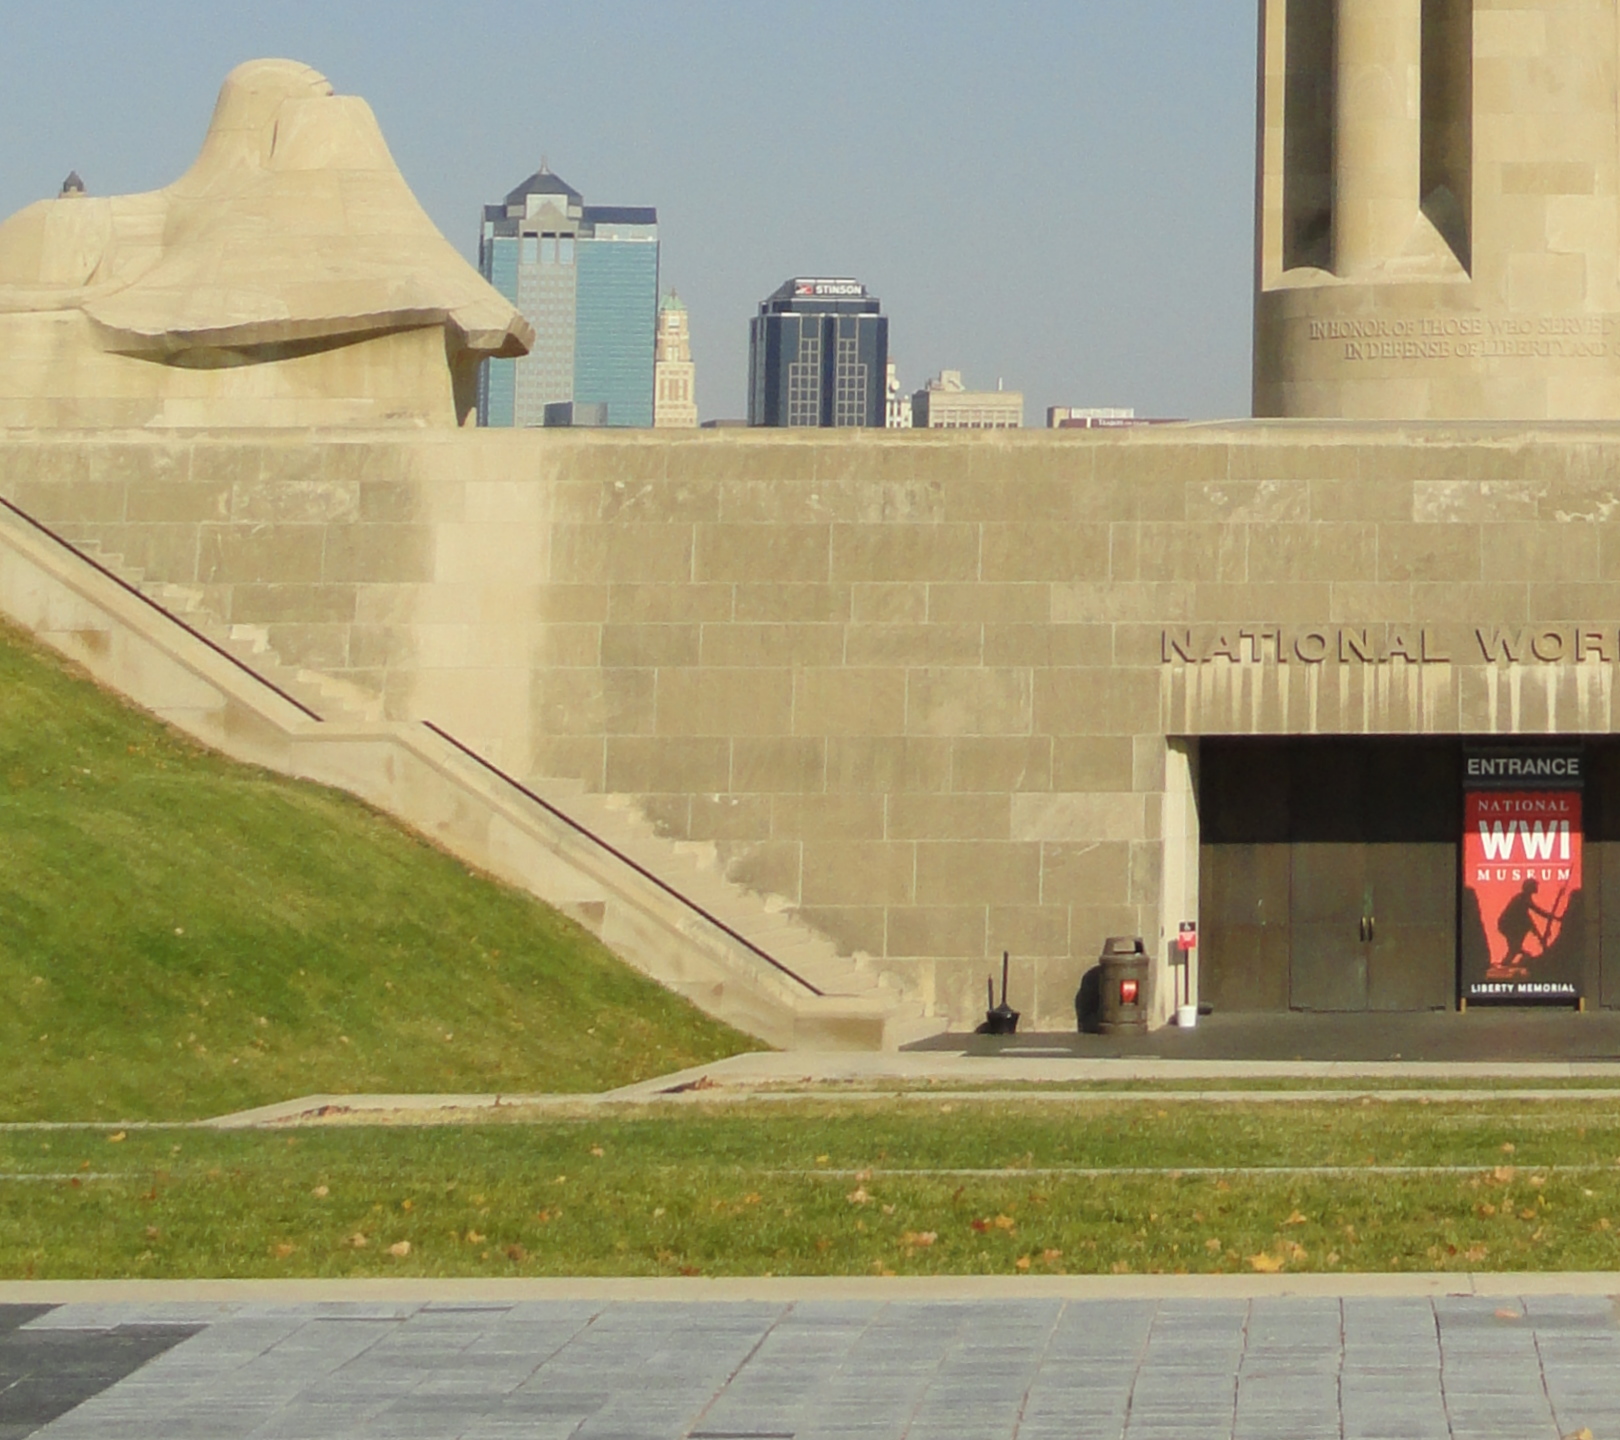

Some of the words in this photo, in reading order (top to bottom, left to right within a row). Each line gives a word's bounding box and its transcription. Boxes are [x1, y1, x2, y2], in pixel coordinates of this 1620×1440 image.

[815, 284, 862, 295] STINSON
[1310, 321, 1326, 340] IN
[1328, 320, 1391, 339] HONOR
[1392, 321, 1415, 337] OF
[1418, 318, 1482, 337] THOSE
[1486, 319, 1534, 336] WHO
[1537, 317, 1615, 336] SERVED
[1343, 342, 1363, 361] IN
[1365, 340, 1450, 360] DEFENSE
[1454, 343, 1478, 358] OF
[1480, 339, 1566, 358] LIBERTY
[1568, 341, 1608, 358] AND
[1160, 628, 1452, 664] NATIONAL
[1467, 758, 1579, 775] ENTRANCE
[1478, 800, 1570, 811] NATIONAL
[1478, 820, 1571, 860] WWI
[1477, 869, 1570, 881] MUSEUM
[1471, 984, 1514, 993] LIBERTY
[1517, 983, 1575, 993] MEMORIAL
